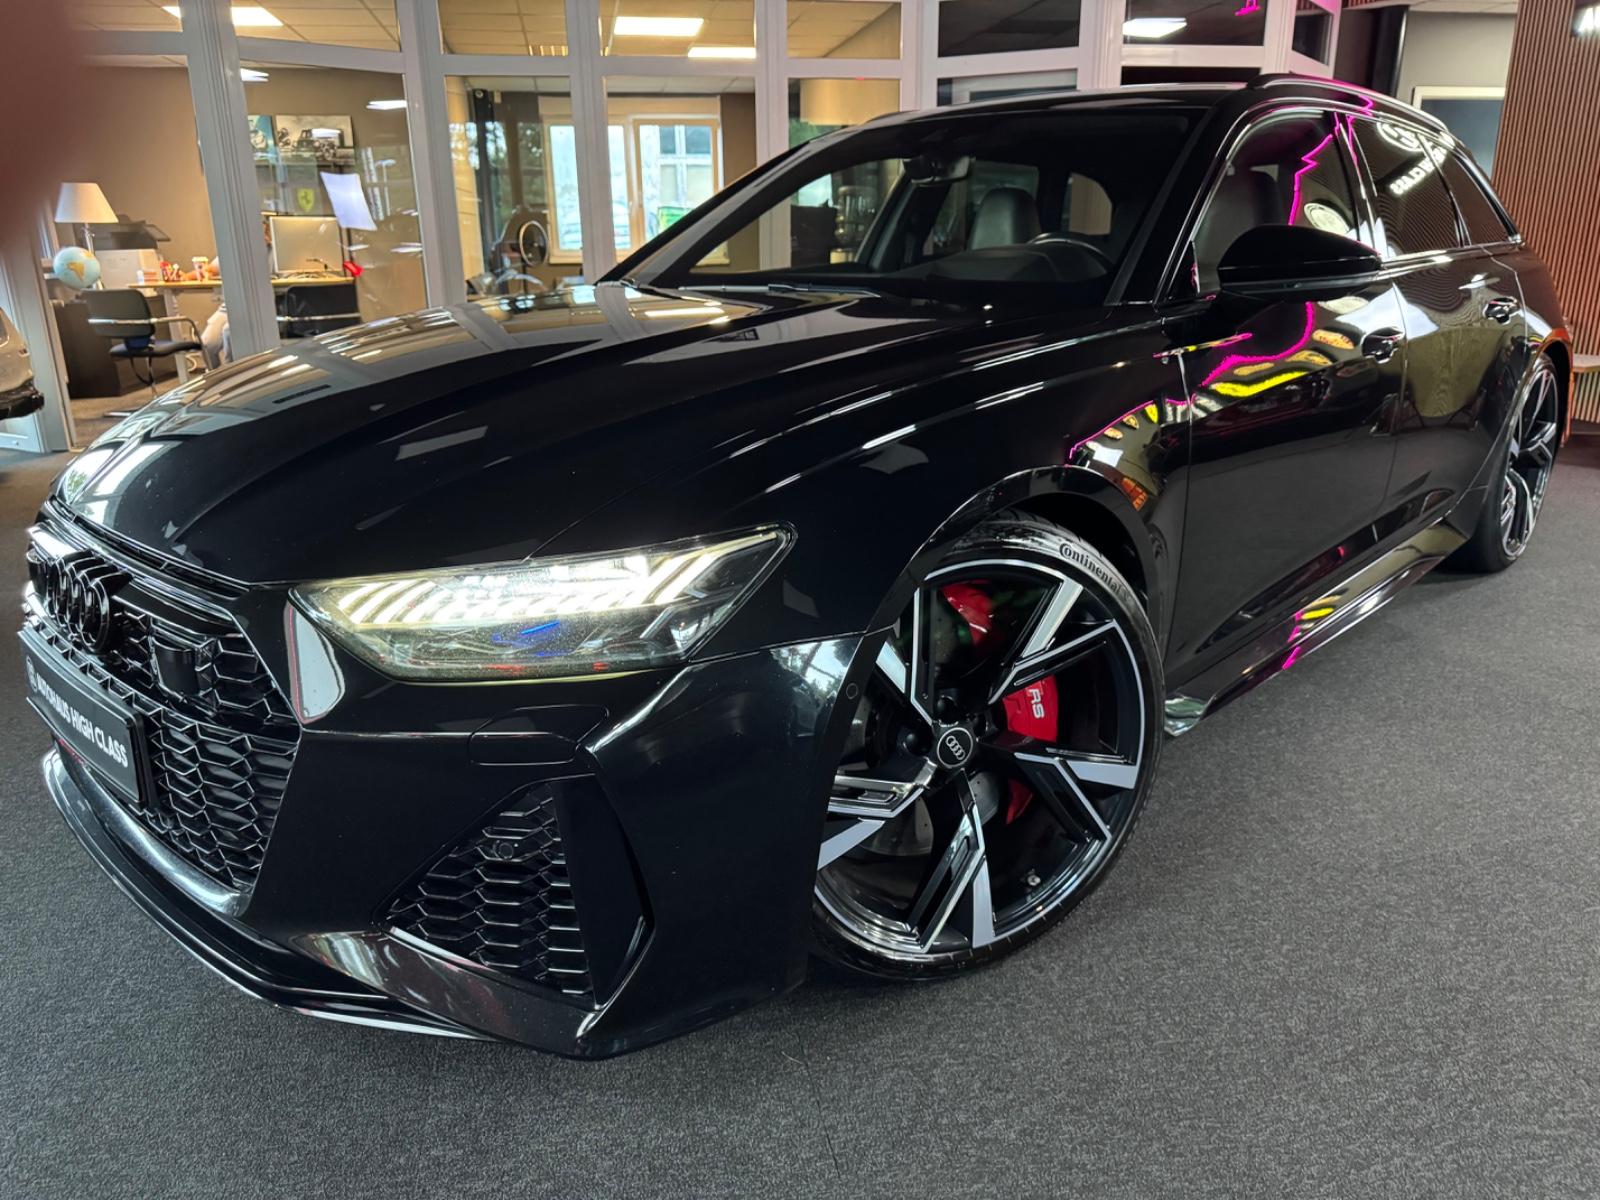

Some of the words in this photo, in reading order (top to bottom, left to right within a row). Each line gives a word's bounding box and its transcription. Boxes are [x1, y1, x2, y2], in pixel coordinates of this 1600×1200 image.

[1059, 542, 1122, 596] Continental
[1029, 687, 1046, 719] RS
[71, 709, 95, 743] HIGH
[93, 727, 129, 768] CLASS
